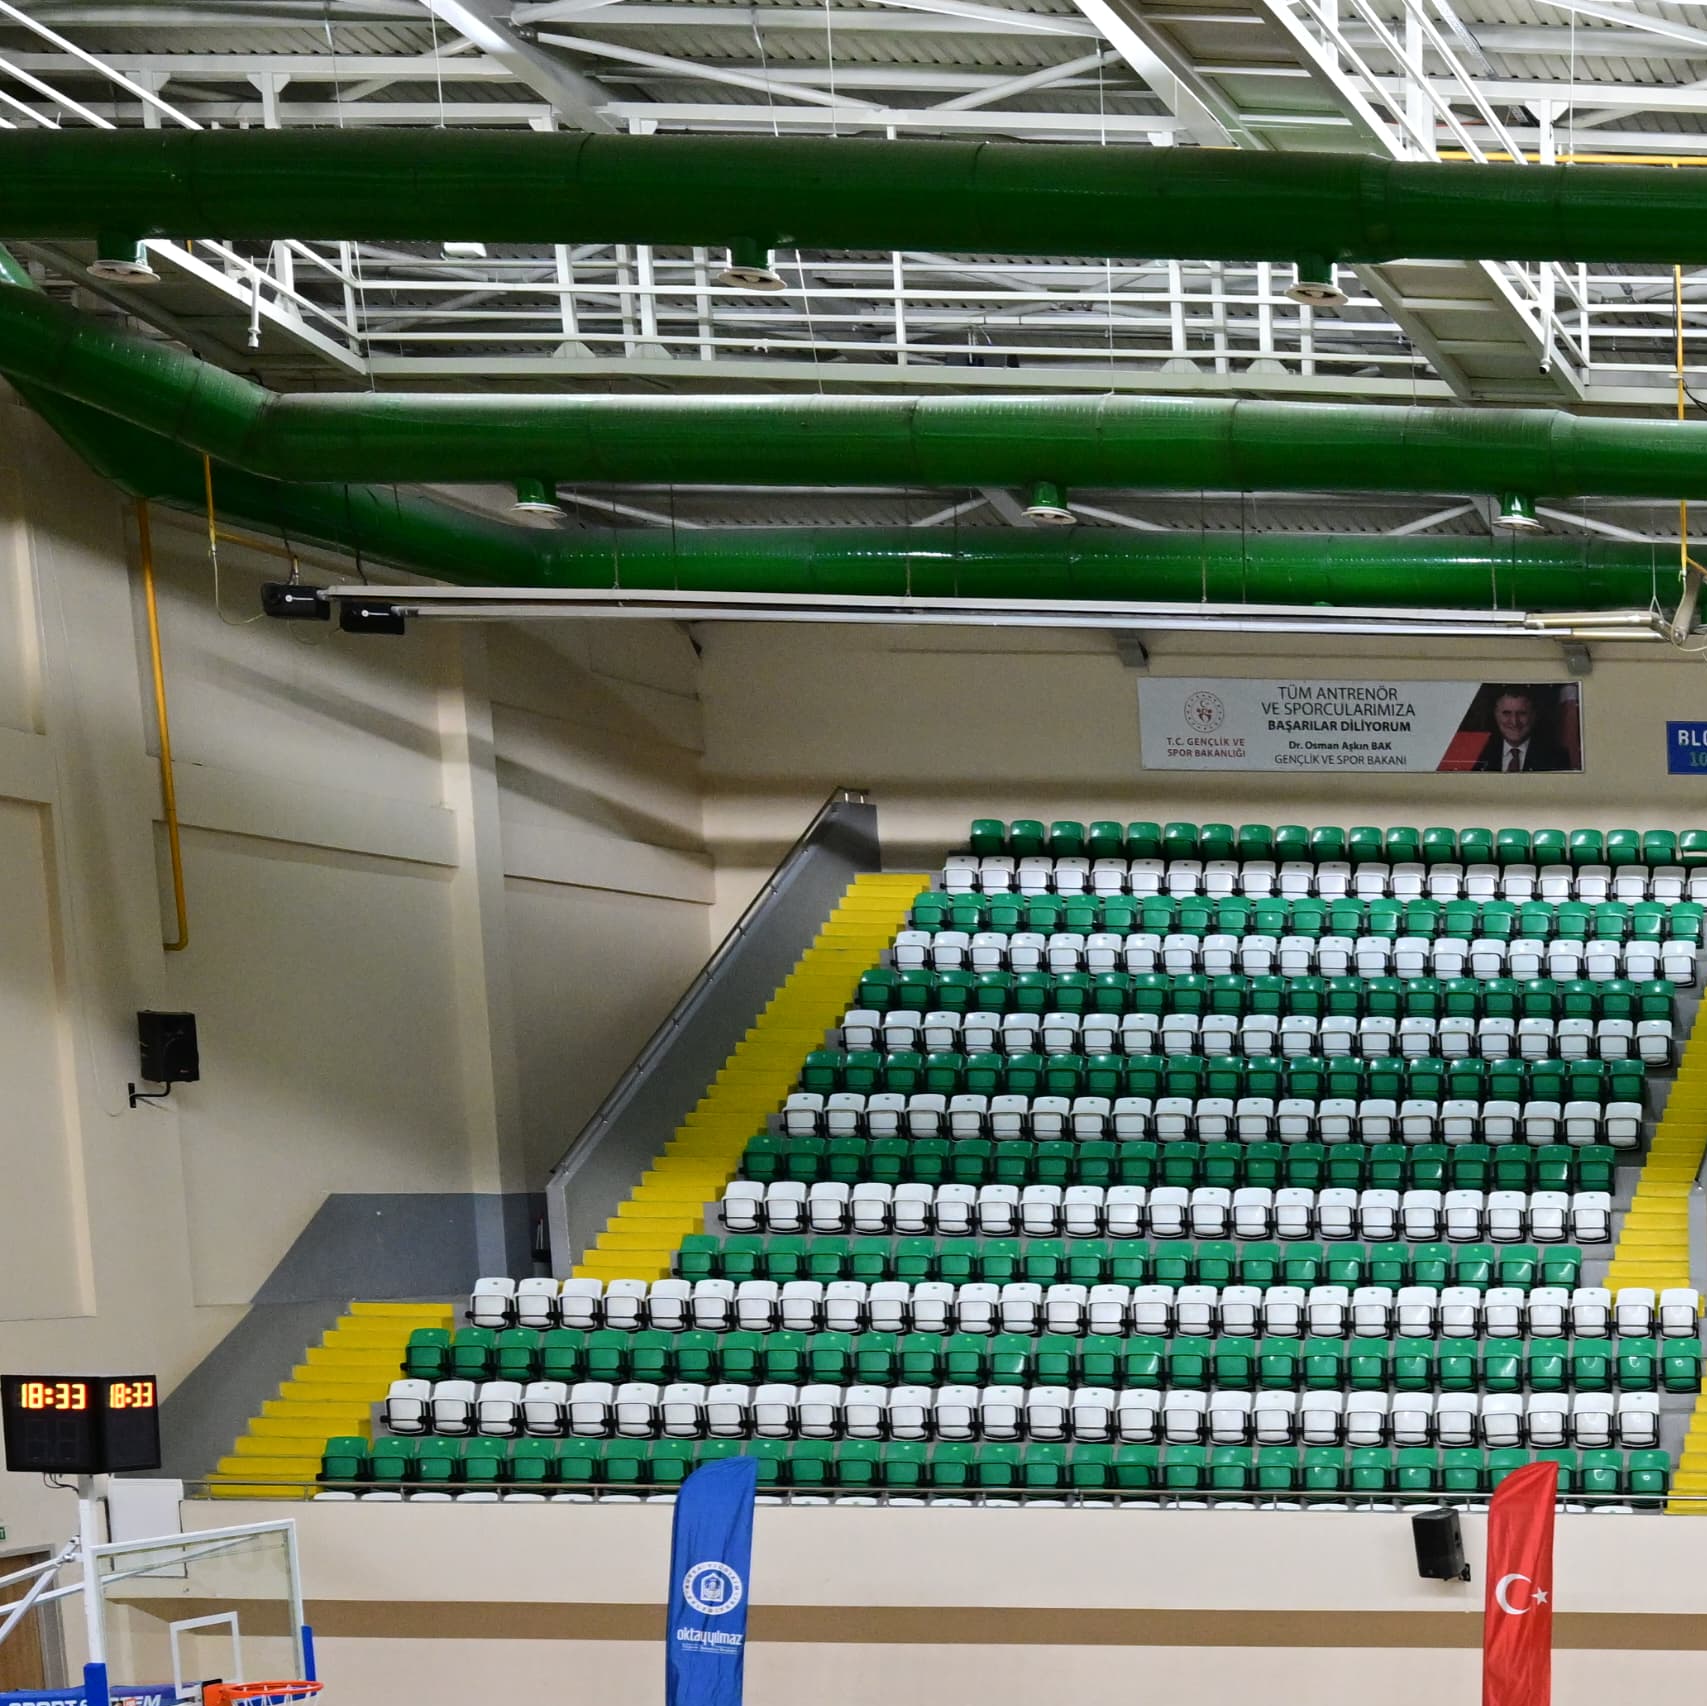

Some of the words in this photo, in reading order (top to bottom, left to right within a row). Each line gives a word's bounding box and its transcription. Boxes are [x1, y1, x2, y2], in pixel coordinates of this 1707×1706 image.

[1278, 684, 1312, 701] TÜM
[1316, 685, 1398, 701] ANTRENÖR
[1261, 702, 1281, 716] VE
[1284, 702, 1416, 717] SPORCULARIMIZA
[1268, 719, 1338, 734] BAŞARILAR
[1340, 719, 1412, 733] DİLİYORUM
[1166, 737, 1185, 747] T.C.
[1186, 736, 1231, 749] GENÇLİK
[1233, 737, 1246, 748] VE
[1288, 740, 1304, 751] Dr.
[1305, 740, 1340, 751] Osman
[1341, 741, 1370, 753] Aşkın
[1371, 741, 1393, 751] BAK
[1167, 747, 1193, 759] SPOR
[1194, 747, 1247, 759] BAKANLIĞI
[1274, 752, 1321, 767] GENÇLİK
[1321, 754, 1335, 766] VE
[1336, 754, 1365, 766] SPOR
[1367, 754, 1407, 766] BAKANI
[20, 1382, 86, 1410] 18:33
[109, 1381, 154, 1409] 18:33
